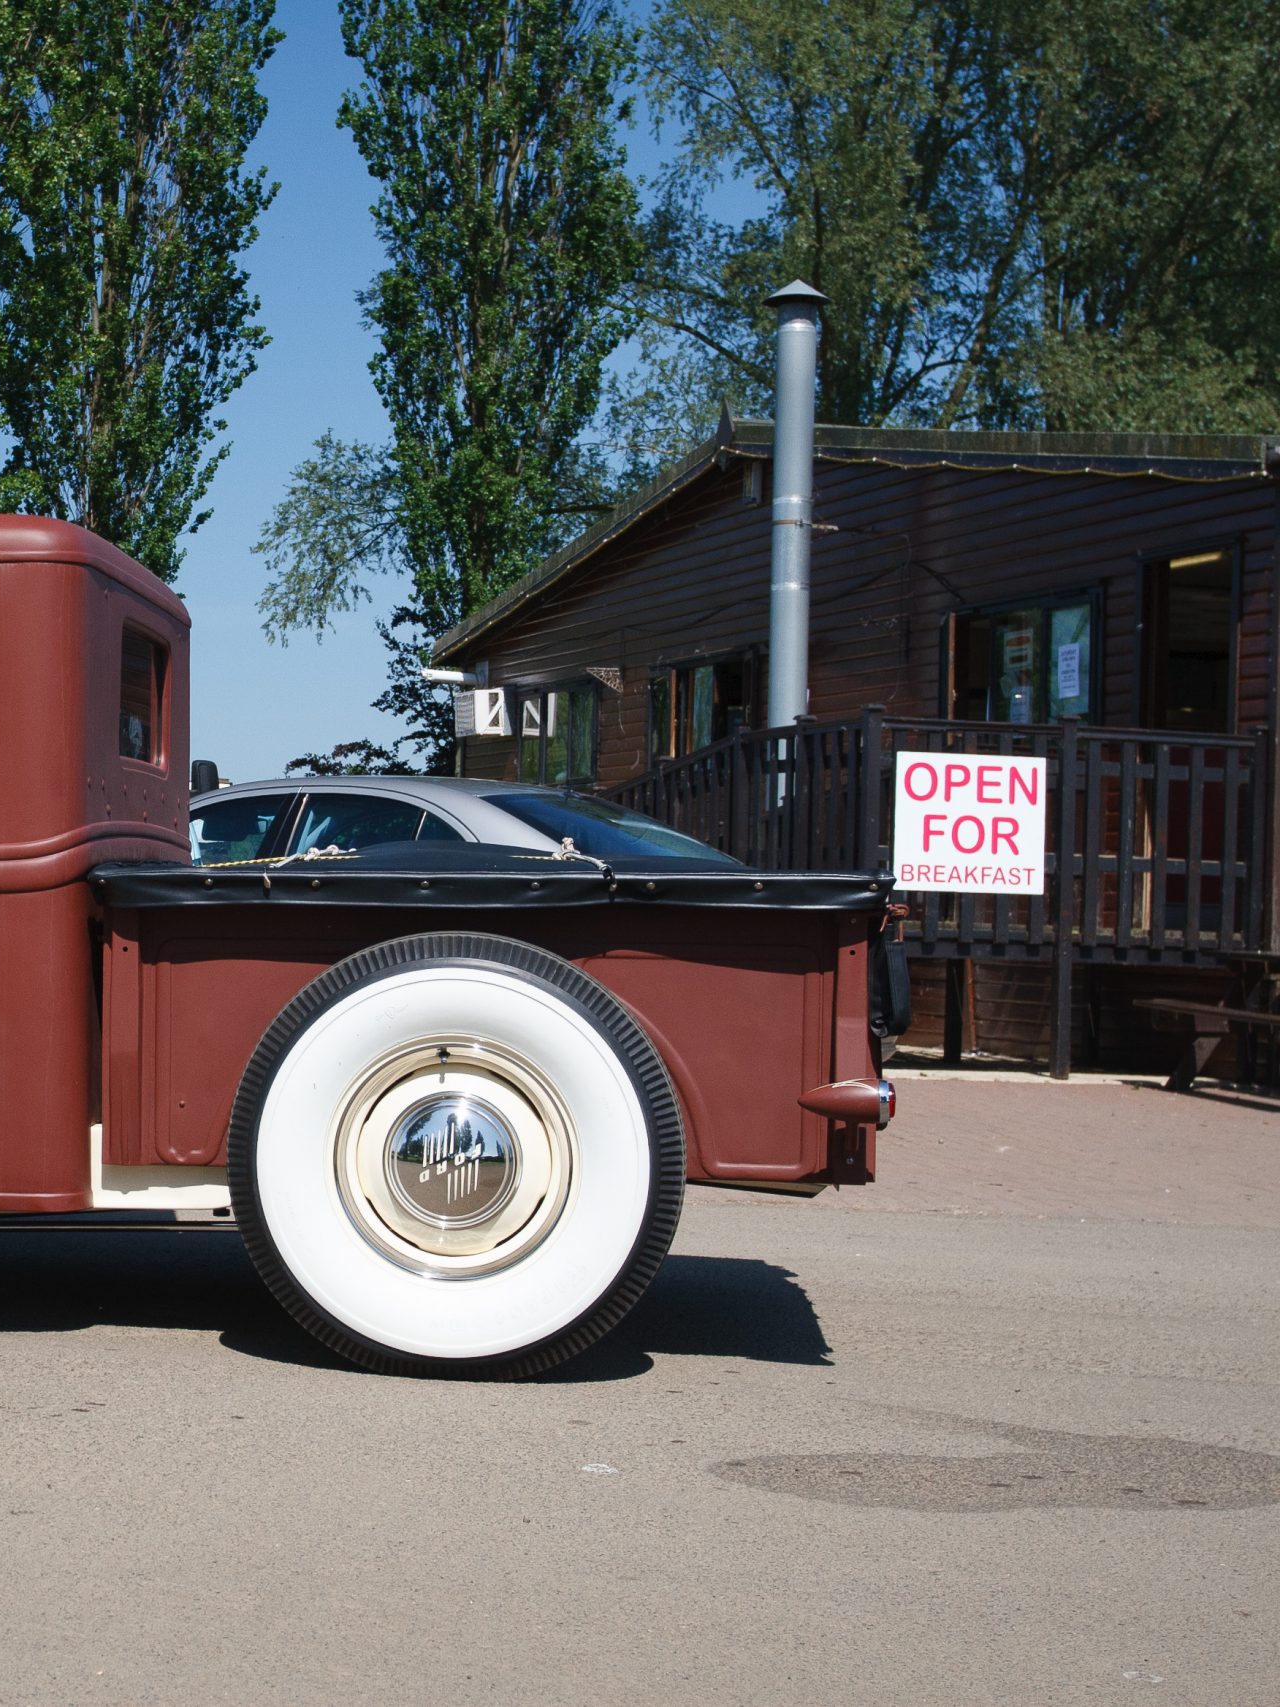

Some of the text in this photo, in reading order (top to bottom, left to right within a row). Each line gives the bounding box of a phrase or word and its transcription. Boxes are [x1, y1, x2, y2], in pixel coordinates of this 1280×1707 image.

[904, 762, 1038, 806] OPEN
[922, 814, 1020, 856] FOR
[901, 864, 1036, 886] BREAKFAST
[418, 1143, 482, 1184] FORD
